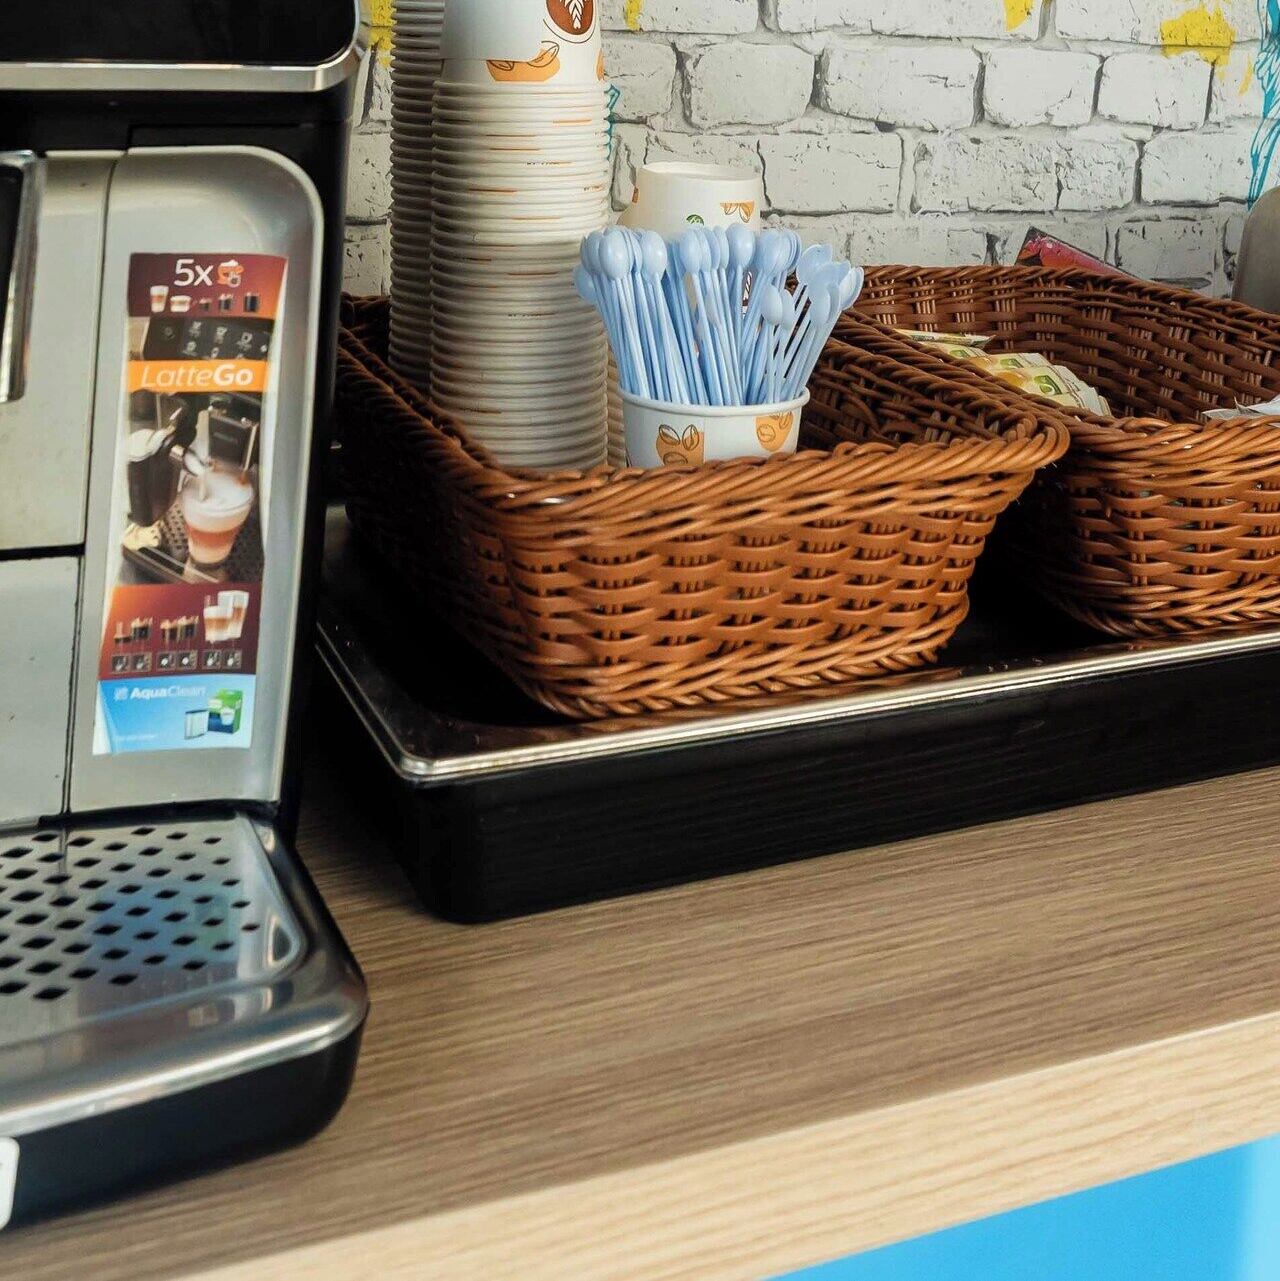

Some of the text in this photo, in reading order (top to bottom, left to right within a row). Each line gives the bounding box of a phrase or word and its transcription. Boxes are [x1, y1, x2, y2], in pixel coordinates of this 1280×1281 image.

[173, 258, 214, 287] 5x
[140, 364, 254, 388] LatteGo
[129, 684, 207, 700] AquaClean
